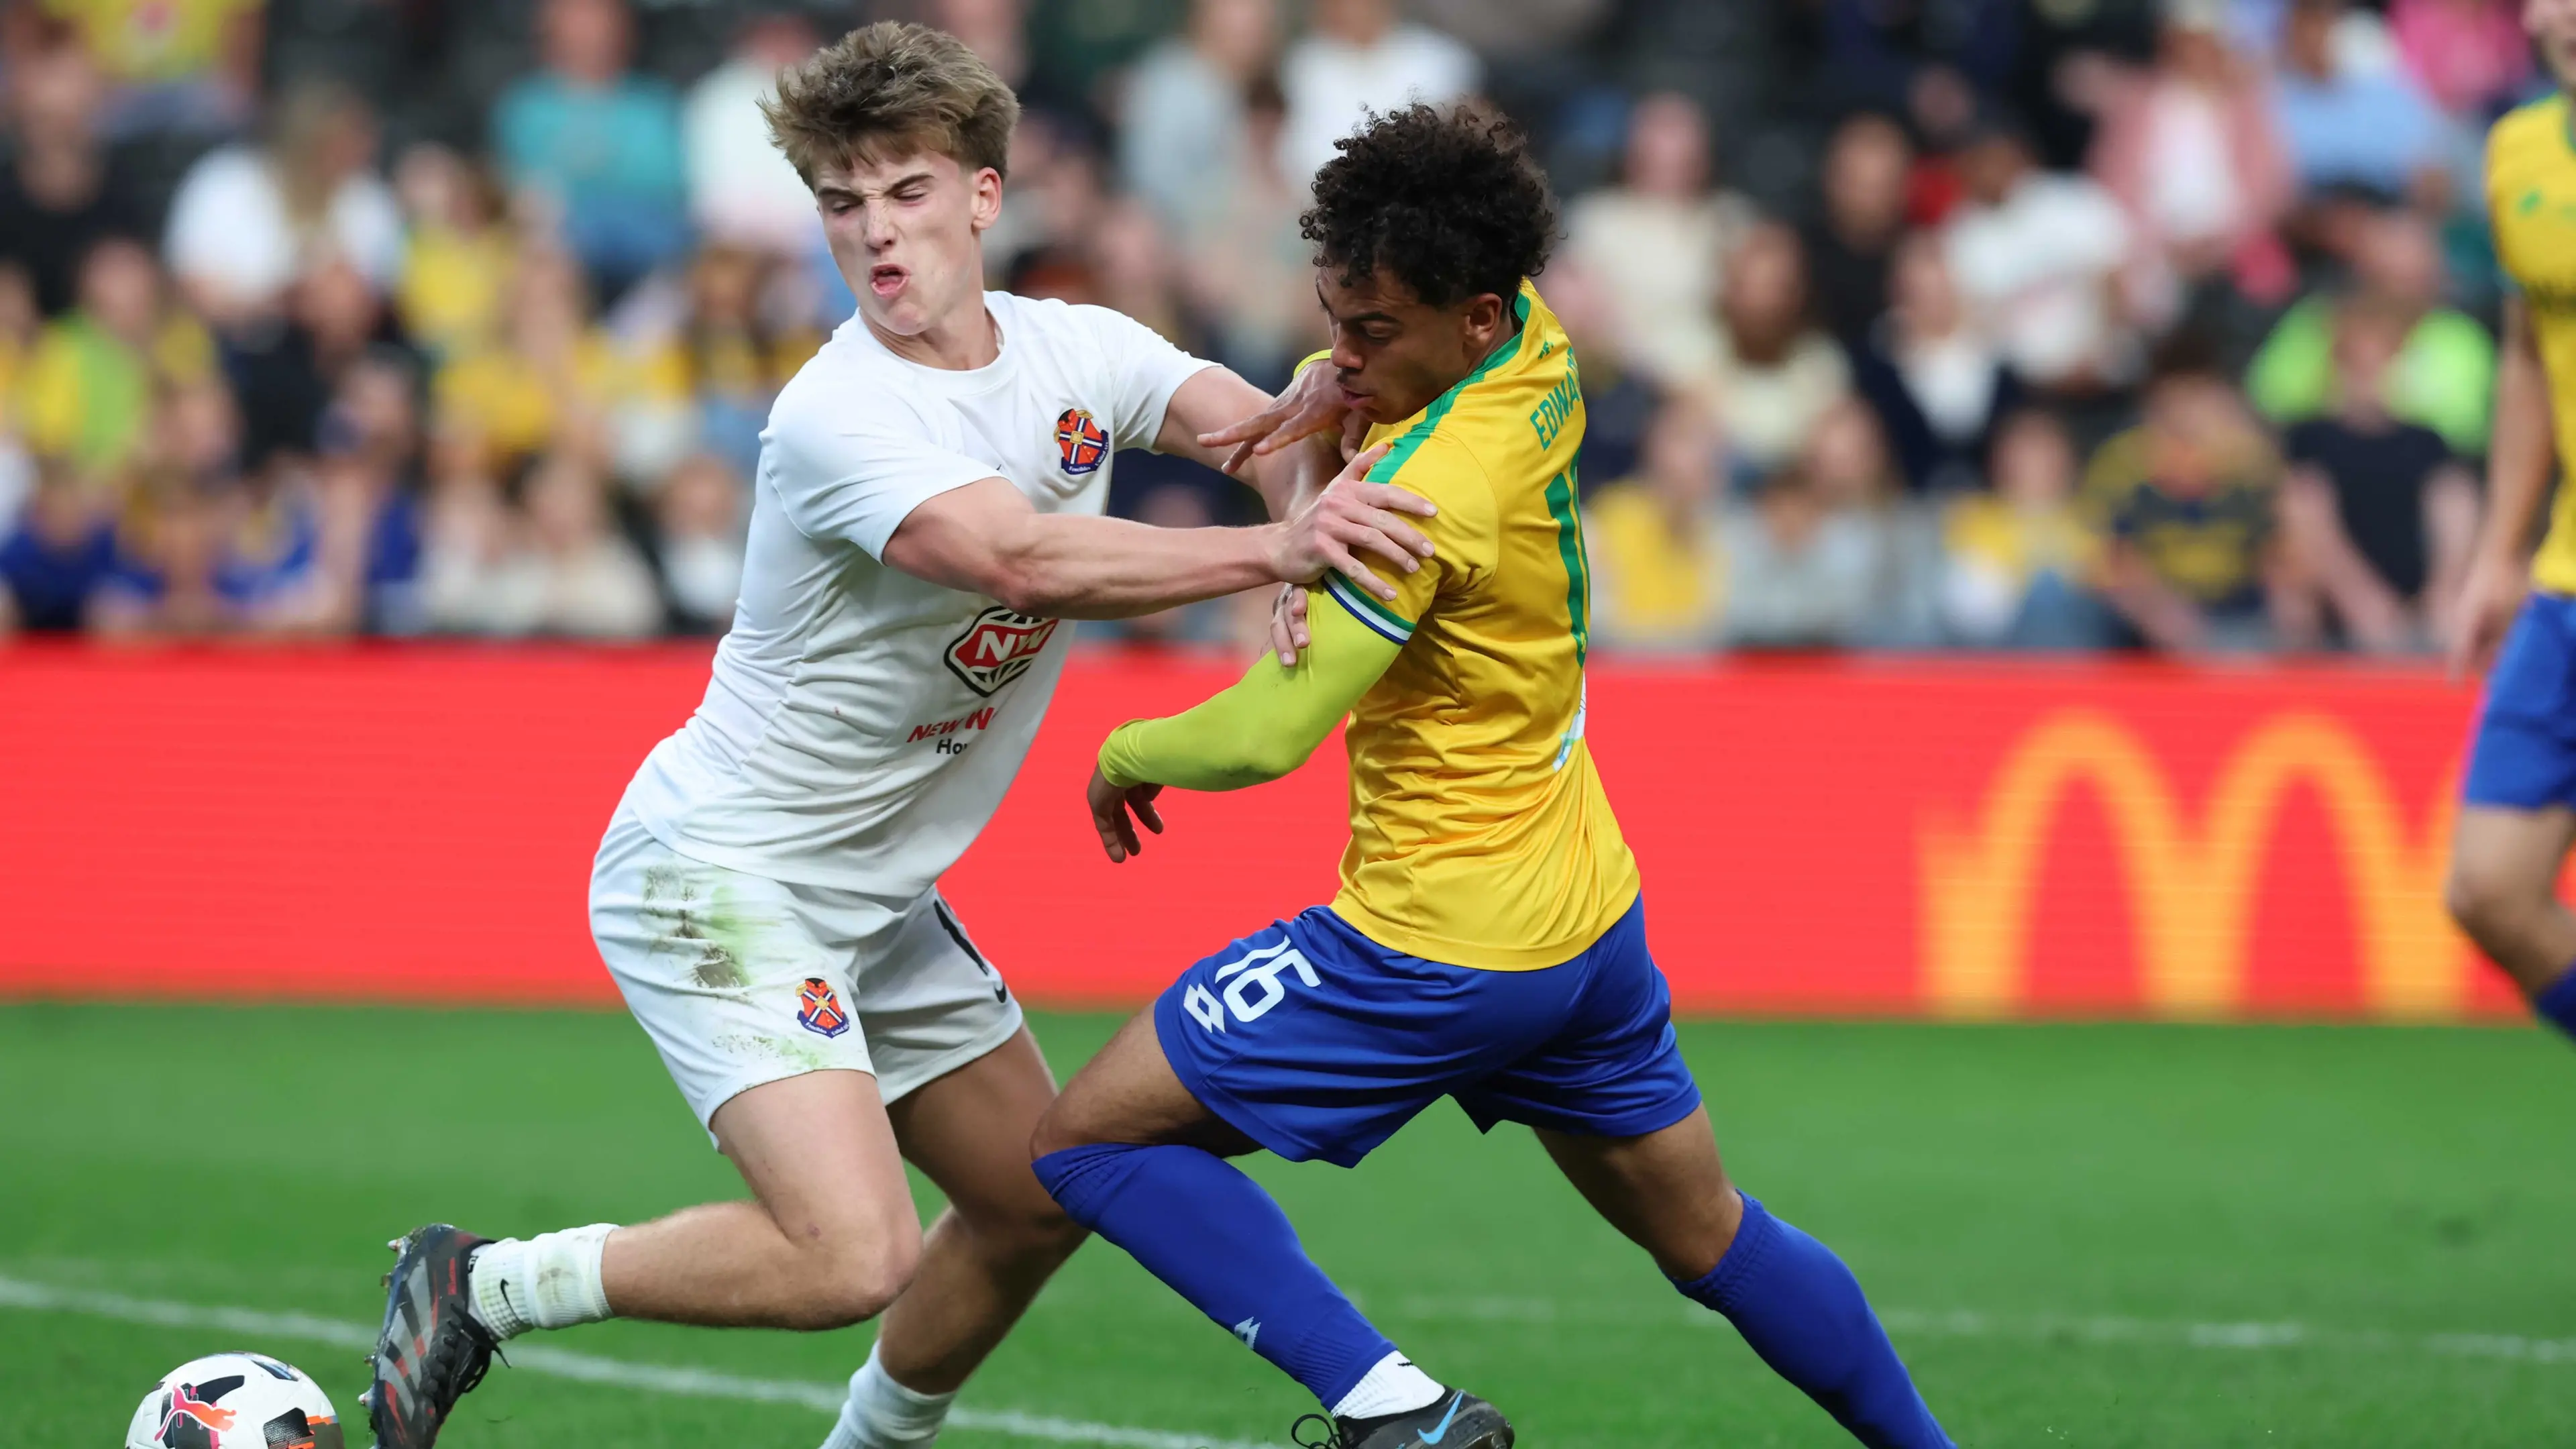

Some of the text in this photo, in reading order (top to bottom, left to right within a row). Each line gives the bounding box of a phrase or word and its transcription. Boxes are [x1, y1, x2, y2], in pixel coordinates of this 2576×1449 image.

[1530, 346, 1580, 451] EDWA
[906, 718, 964, 743] NEW
[936, 738, 967, 755] Ho
[1215, 934, 1322, 1022] 16
